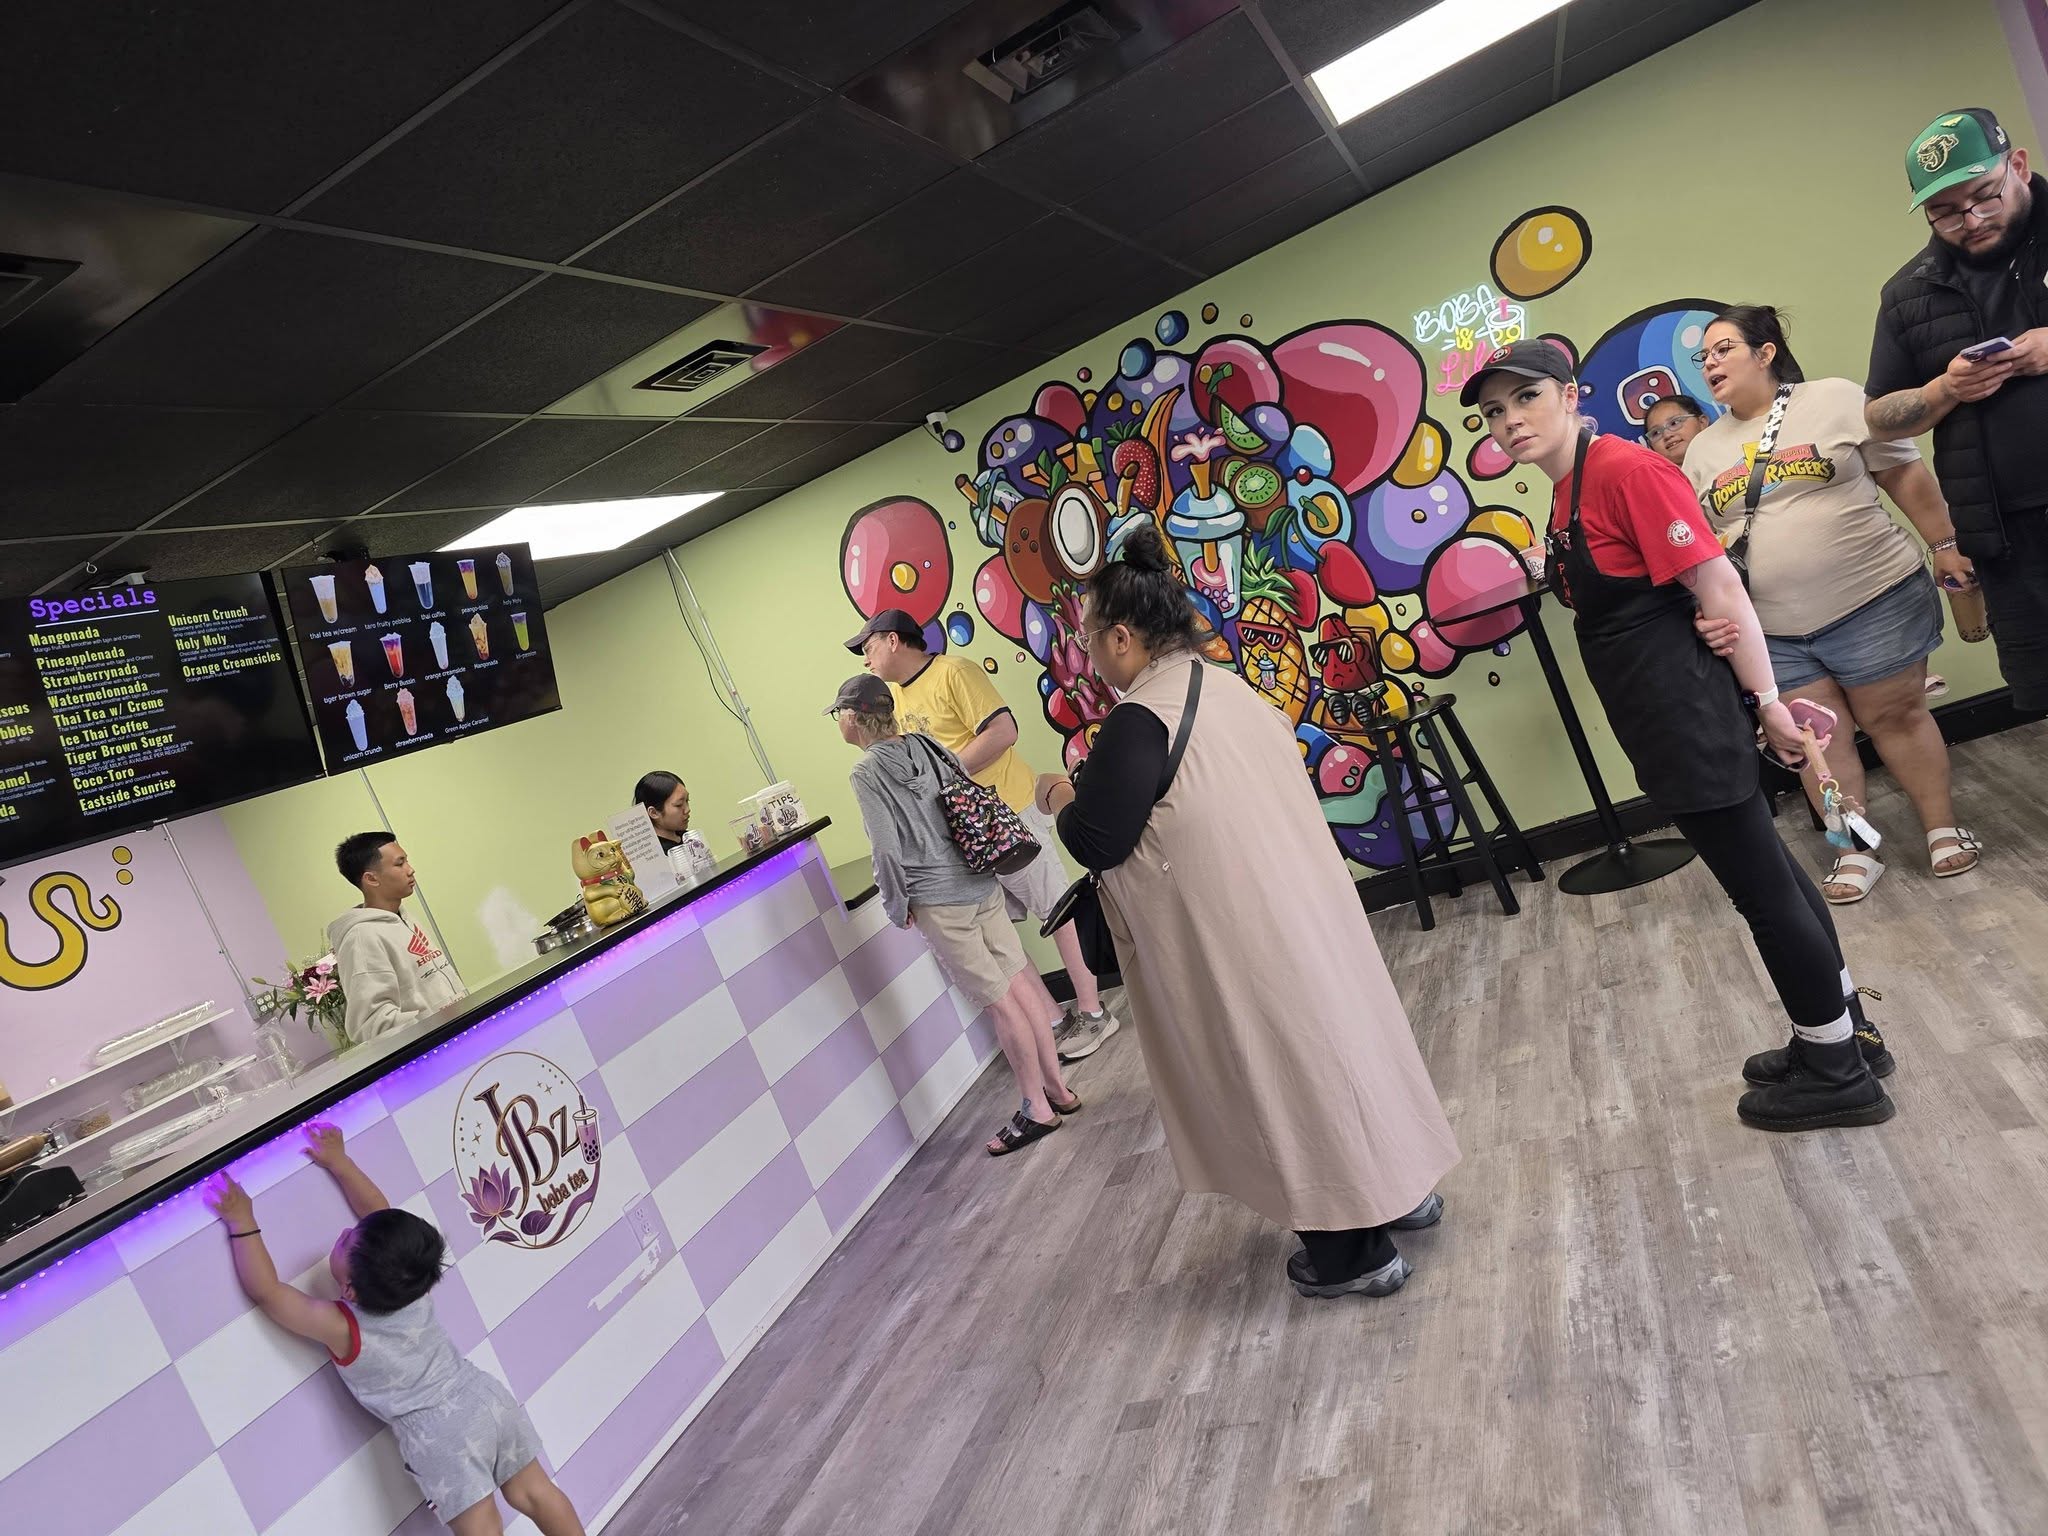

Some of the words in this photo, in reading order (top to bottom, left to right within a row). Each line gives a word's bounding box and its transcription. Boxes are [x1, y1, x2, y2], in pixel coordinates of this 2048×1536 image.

[1413, 284, 1496, 343] BOBA
[1435, 340, 1488, 396] Lif
[1765, 460, 1832, 484] RANGERS
[29, 587, 157, 621] Specials
[168, 613, 210, 626] Unicorn
[212, 606, 248, 620] Crunch
[431, 611, 446, 619] coffee
[310, 631, 321, 640] thai
[333, 626, 358, 636] w/cream
[364, 622, 376, 630] taro
[376, 619, 391, 628] fruity
[391, 617, 412, 626] pebbles
[29, 626, 100, 646] Mangonada
[176, 637, 199, 650] Holy
[202, 633, 226, 646] Moly
[36, 646, 125, 670] Pineapplenada
[182, 663, 220, 677] Orange
[222, 651, 281, 670] Creamsicles
[42, 663, 138, 689] Strawberrynada
[47, 680, 148, 708] Watermelonnada
[323, 695, 337, 704] tiger
[338, 691, 356, 700] brown
[356, 687, 372, 697] sugar
[53, 711, 81, 727] Thai
[83, 709, 106, 721] Tea
[109, 703, 122, 716] w/
[127, 699, 164, 712] Creme
[60, 735, 80, 747] Ice
[81, 726, 109, 742] Thai
[111, 720, 149, 736] Coffee
[64, 750, 97, 765] Tiger
[100, 741, 138, 757] Brown
[140, 733, 173, 748] Sugar
[343, 750, 364, 762] unicorn
[364, 745, 383, 756] crunch
[73, 768, 134, 790] Coco-Toro
[79, 789, 130, 811] Eastside
[133, 779, 176, 797] Sunrise
[768, 793, 794, 809] TIPS
[416, 949, 442, 967] HOND
[536, 1183, 571, 1215] boba
[567, 1167, 590, 1192] tea
